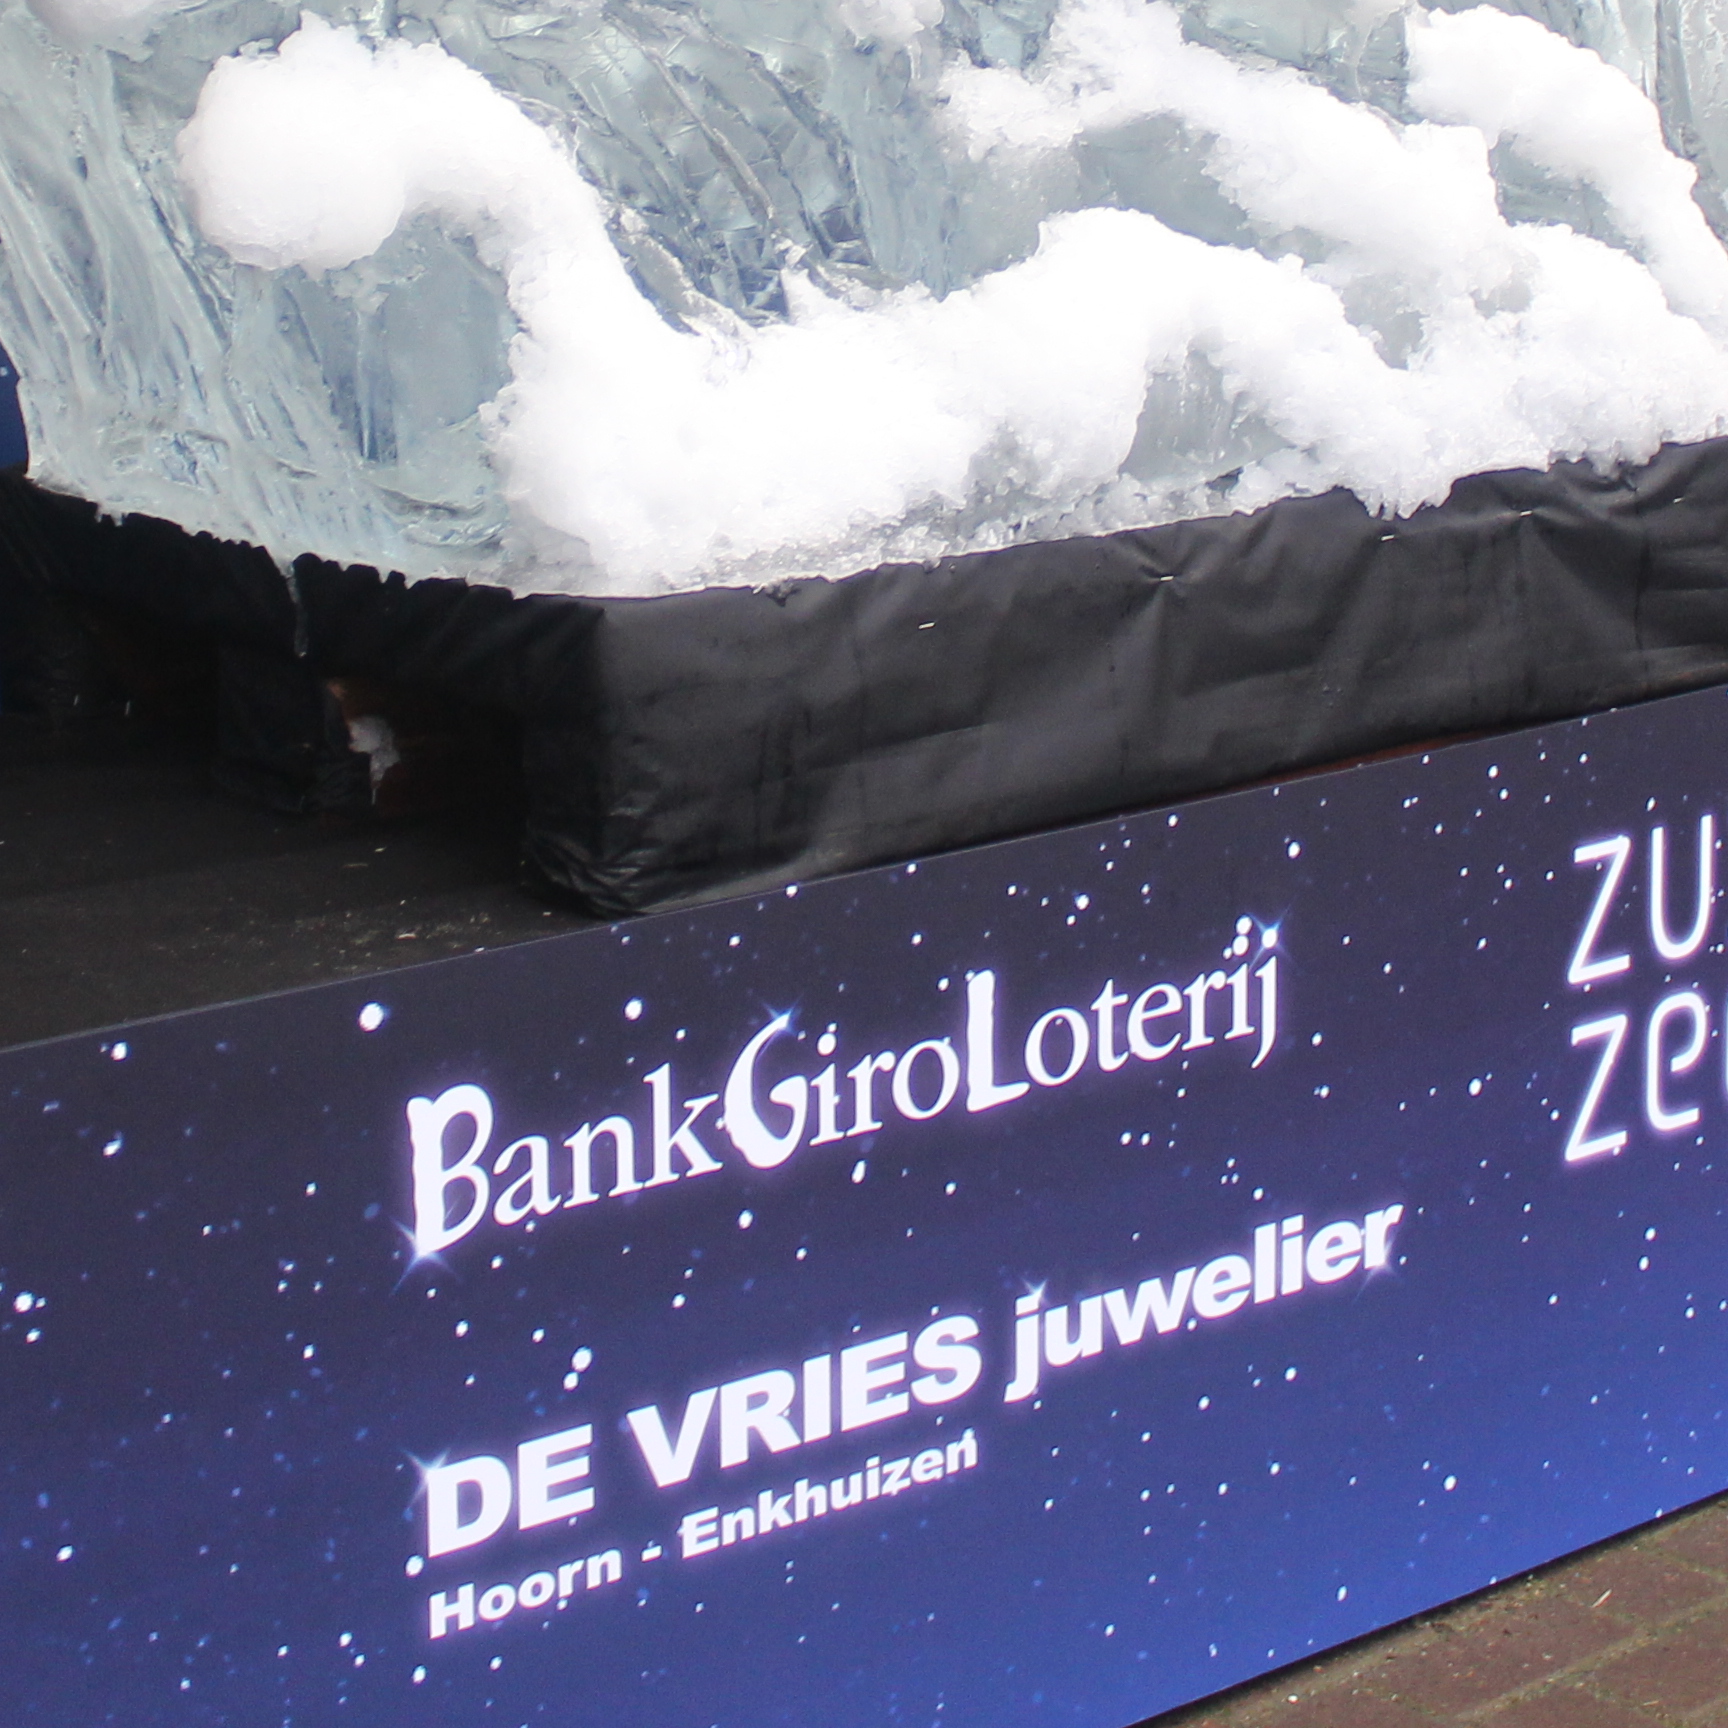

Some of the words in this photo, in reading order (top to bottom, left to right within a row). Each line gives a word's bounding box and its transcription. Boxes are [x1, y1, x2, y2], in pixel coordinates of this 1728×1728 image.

[404, 924, 1279, 1260] BankGiroLoterij
[422, 1423, 595, 1559] DE
[626, 1313, 983, 1488] VRIES
[1002, 1203, 1404, 1403] juwelier
[429, 1549, 622, 1640] Hoorn
[677, 1427, 978, 1559] Enkhuizen
